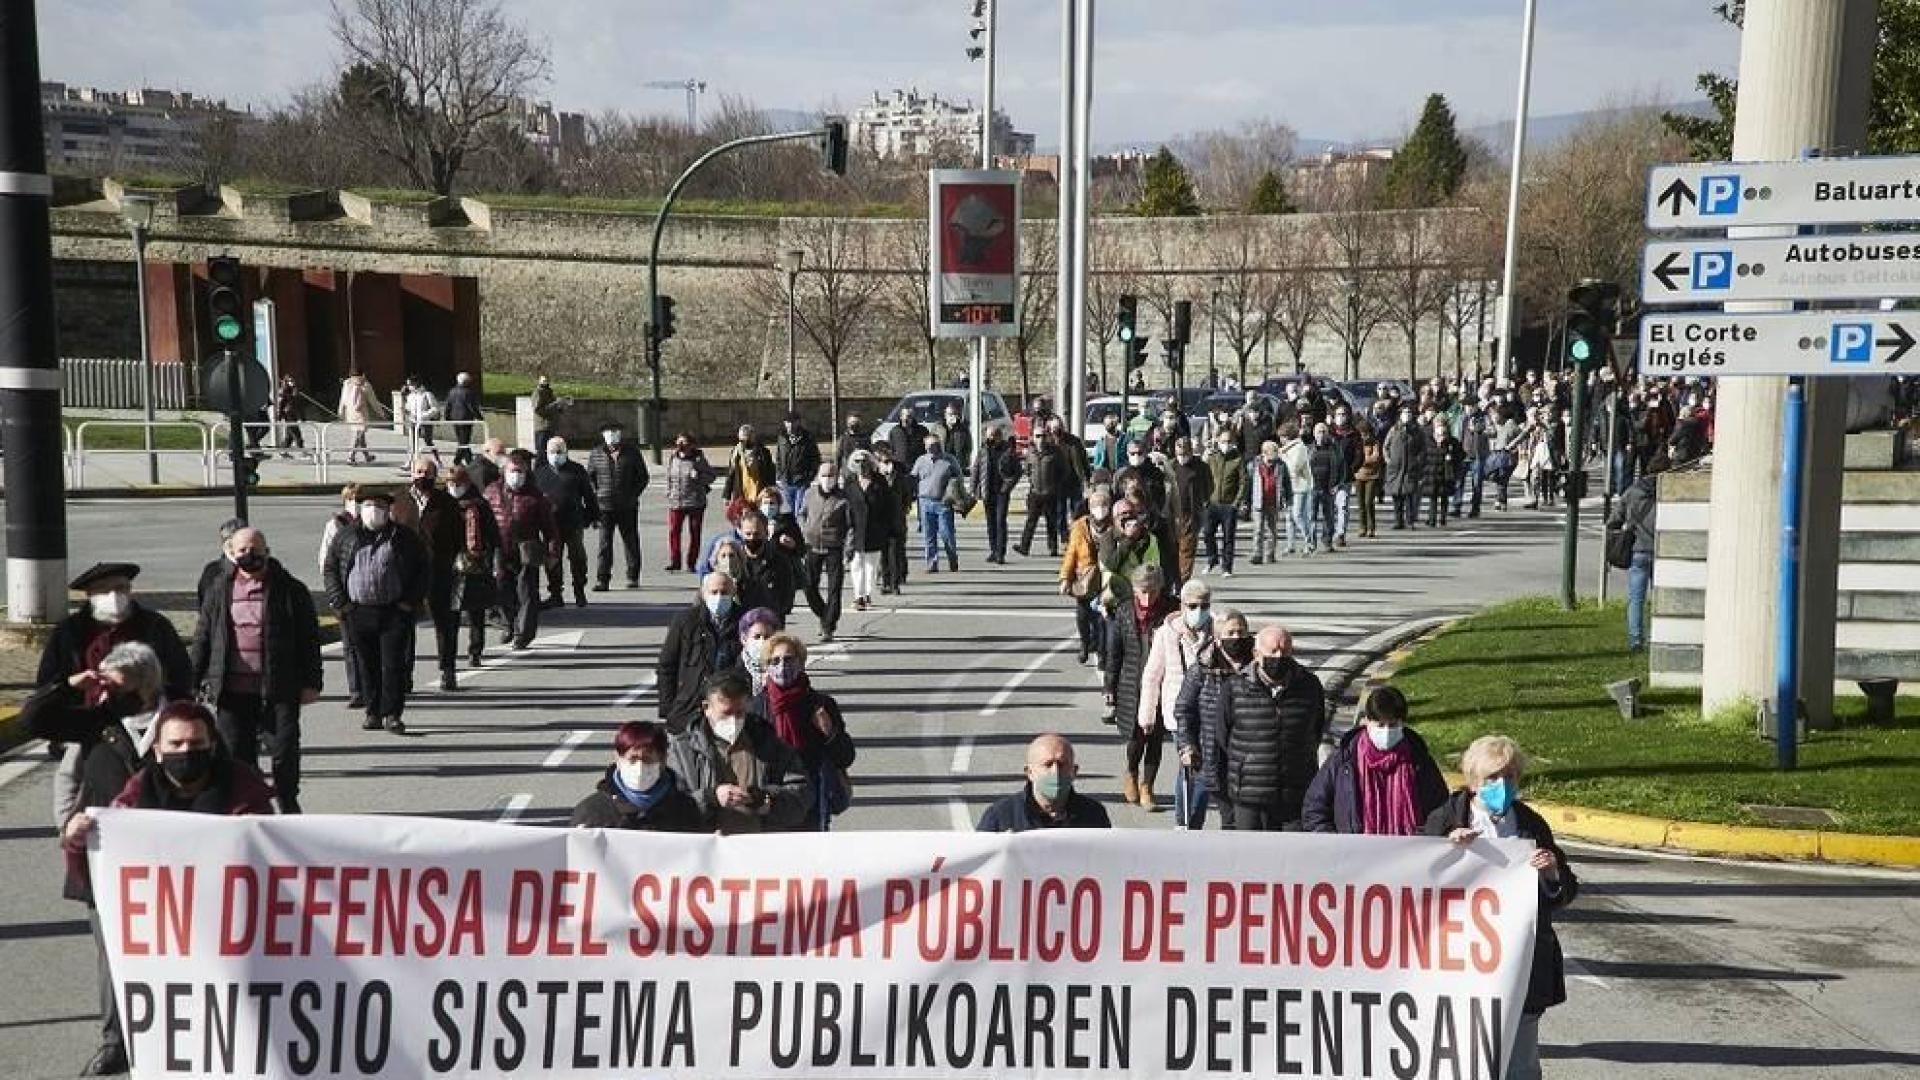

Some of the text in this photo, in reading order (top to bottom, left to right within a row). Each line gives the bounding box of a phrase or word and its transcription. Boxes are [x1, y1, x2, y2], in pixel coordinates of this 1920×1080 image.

[1707, 179, 1733, 212] P
[1699, 243, 1920, 287] P Autobuses
[1651, 324, 1757, 342] El Corte
[1840, 327, 1864, 360] P
[1649, 347, 1725, 370] Inglés
[120, 857, 1501, 973] EN DEFENSA DEL SISTEMA PÚBLICO DE PENSIONES
[124, 979, 1503, 1080] PENTSIO SISTEMA PUBLIKOAREN DEFENTSAN
